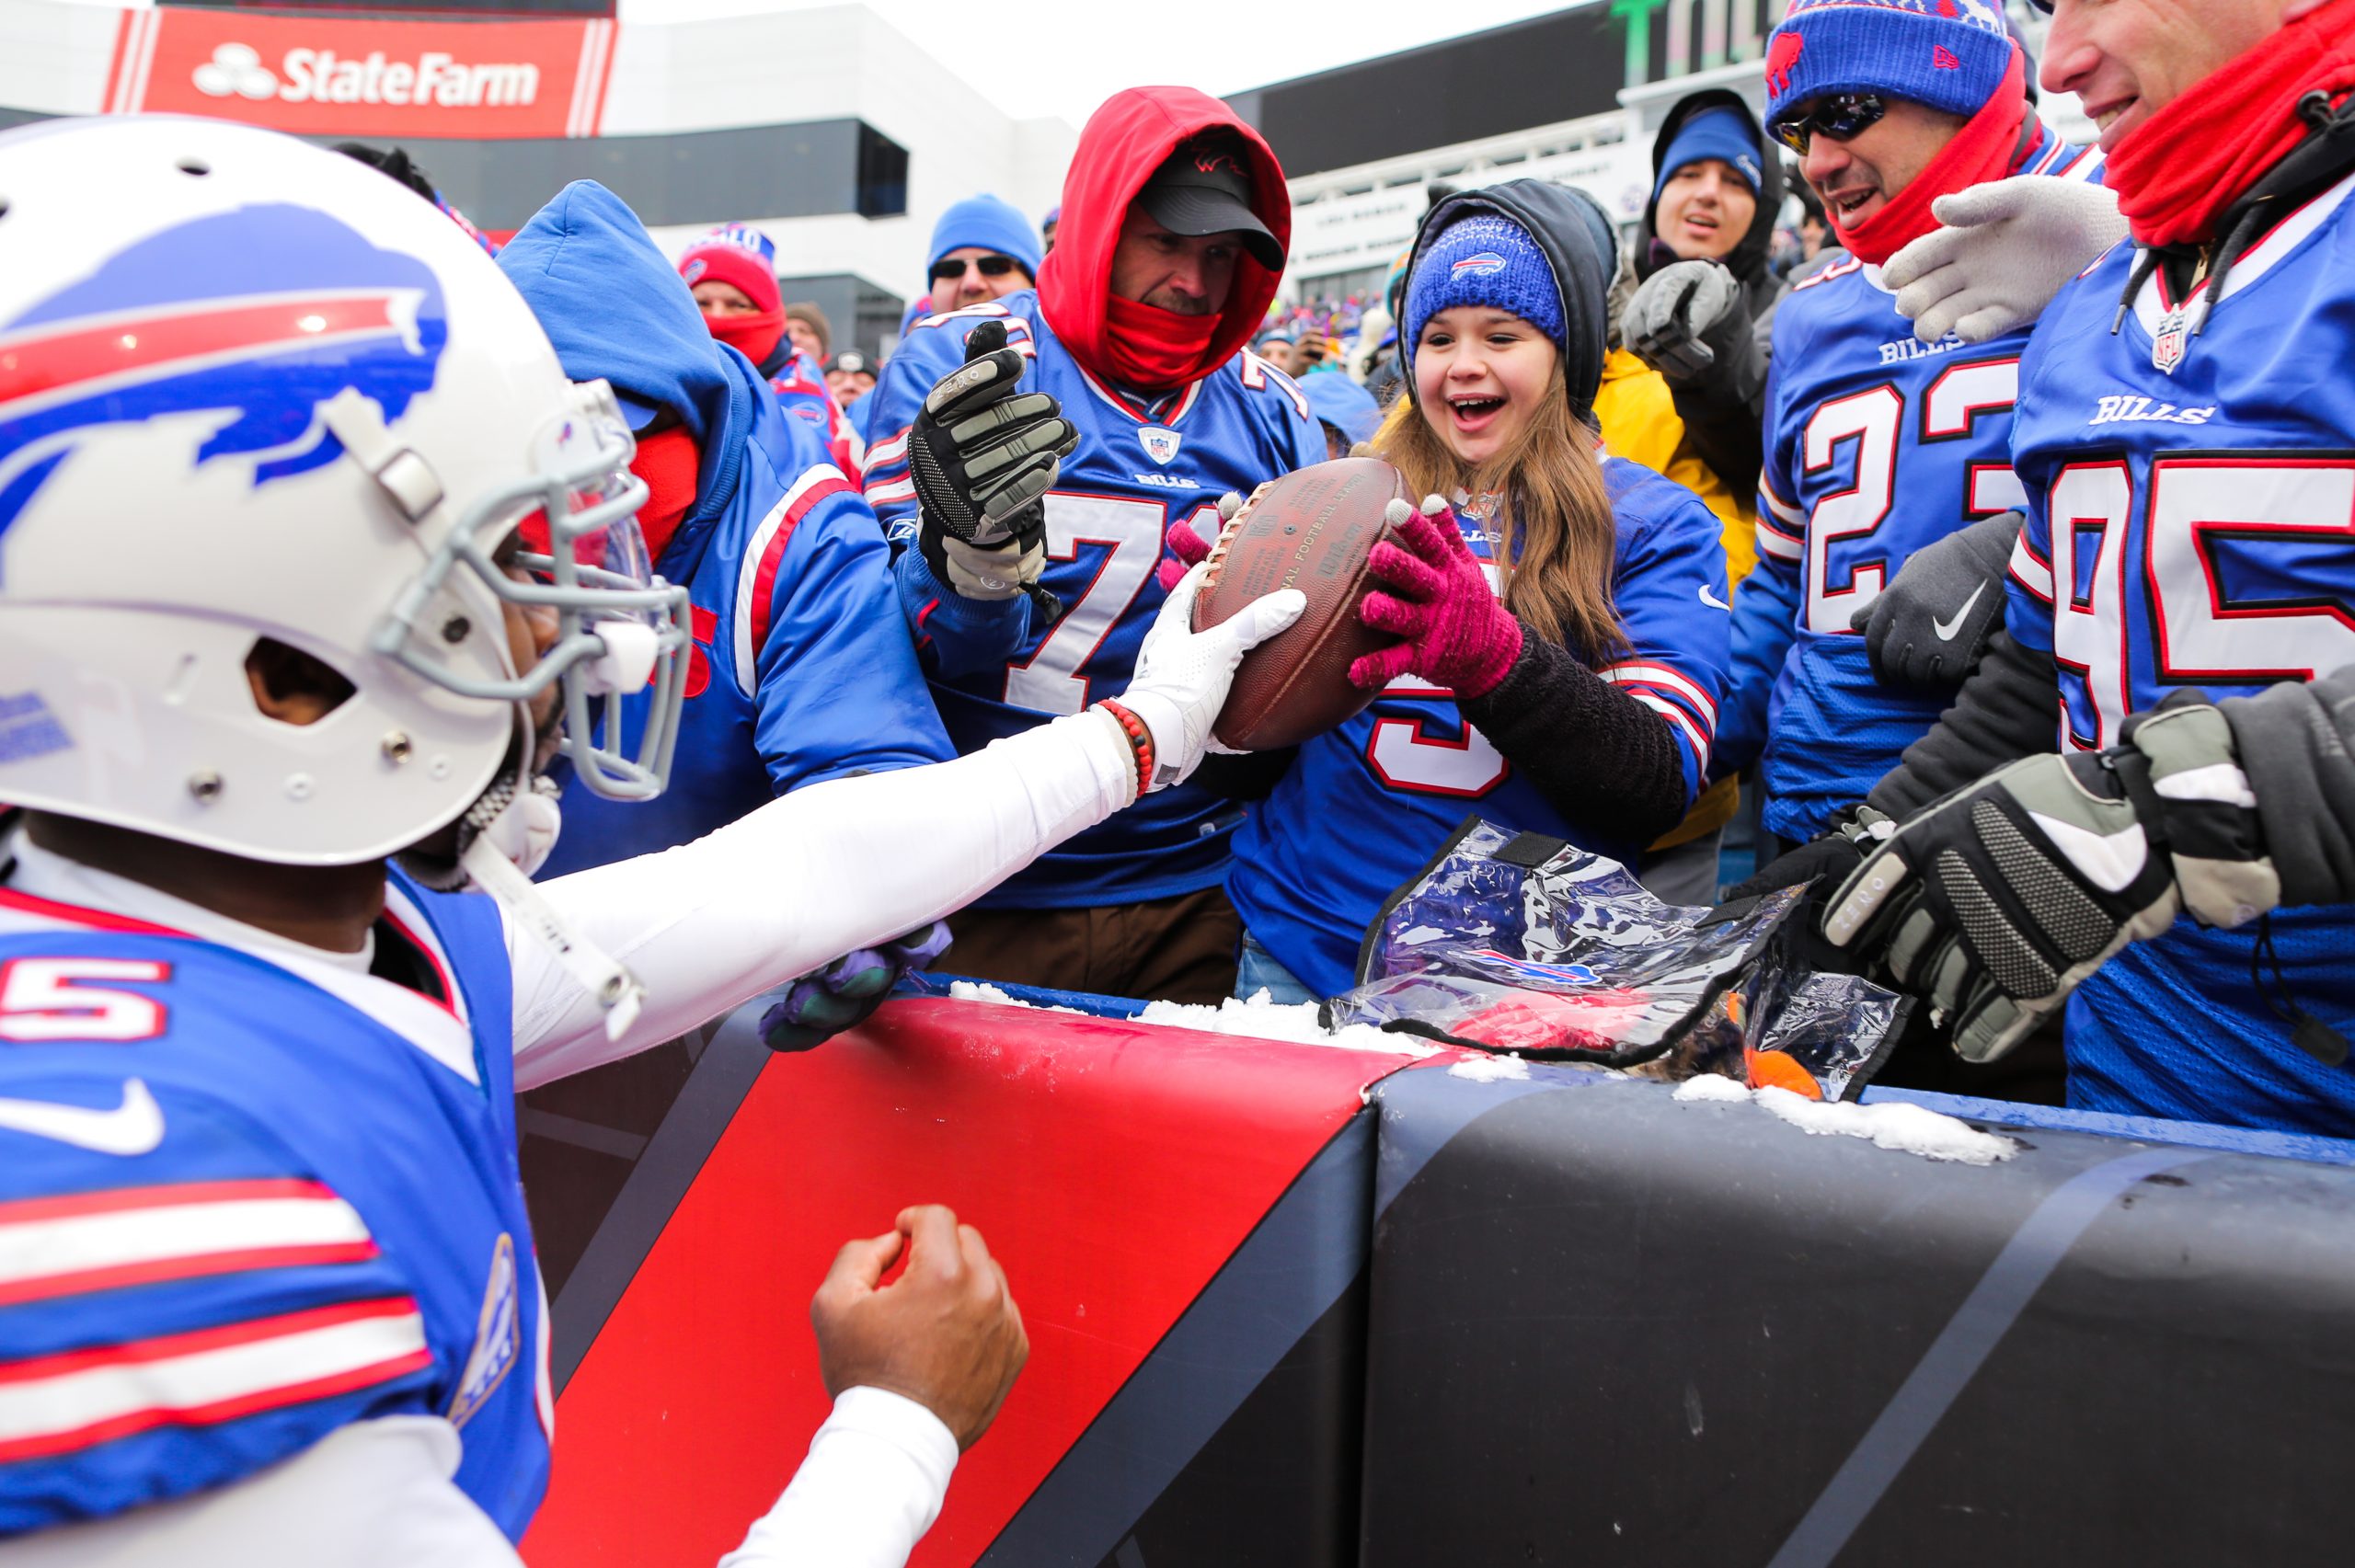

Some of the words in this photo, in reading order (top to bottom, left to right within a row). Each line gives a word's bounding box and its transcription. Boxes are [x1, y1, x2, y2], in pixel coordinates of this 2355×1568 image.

[1878, 330, 1966, 365] BILLS
[2156, 333, 2179, 362] NFL
[2088, 395, 2216, 426] BILLS
[1133, 474, 1200, 489] BILLS
[1294, 503, 1338, 562] FOOTBALL
[2046, 450, 2355, 756] 95
[0, 954, 172, 1044] 5
